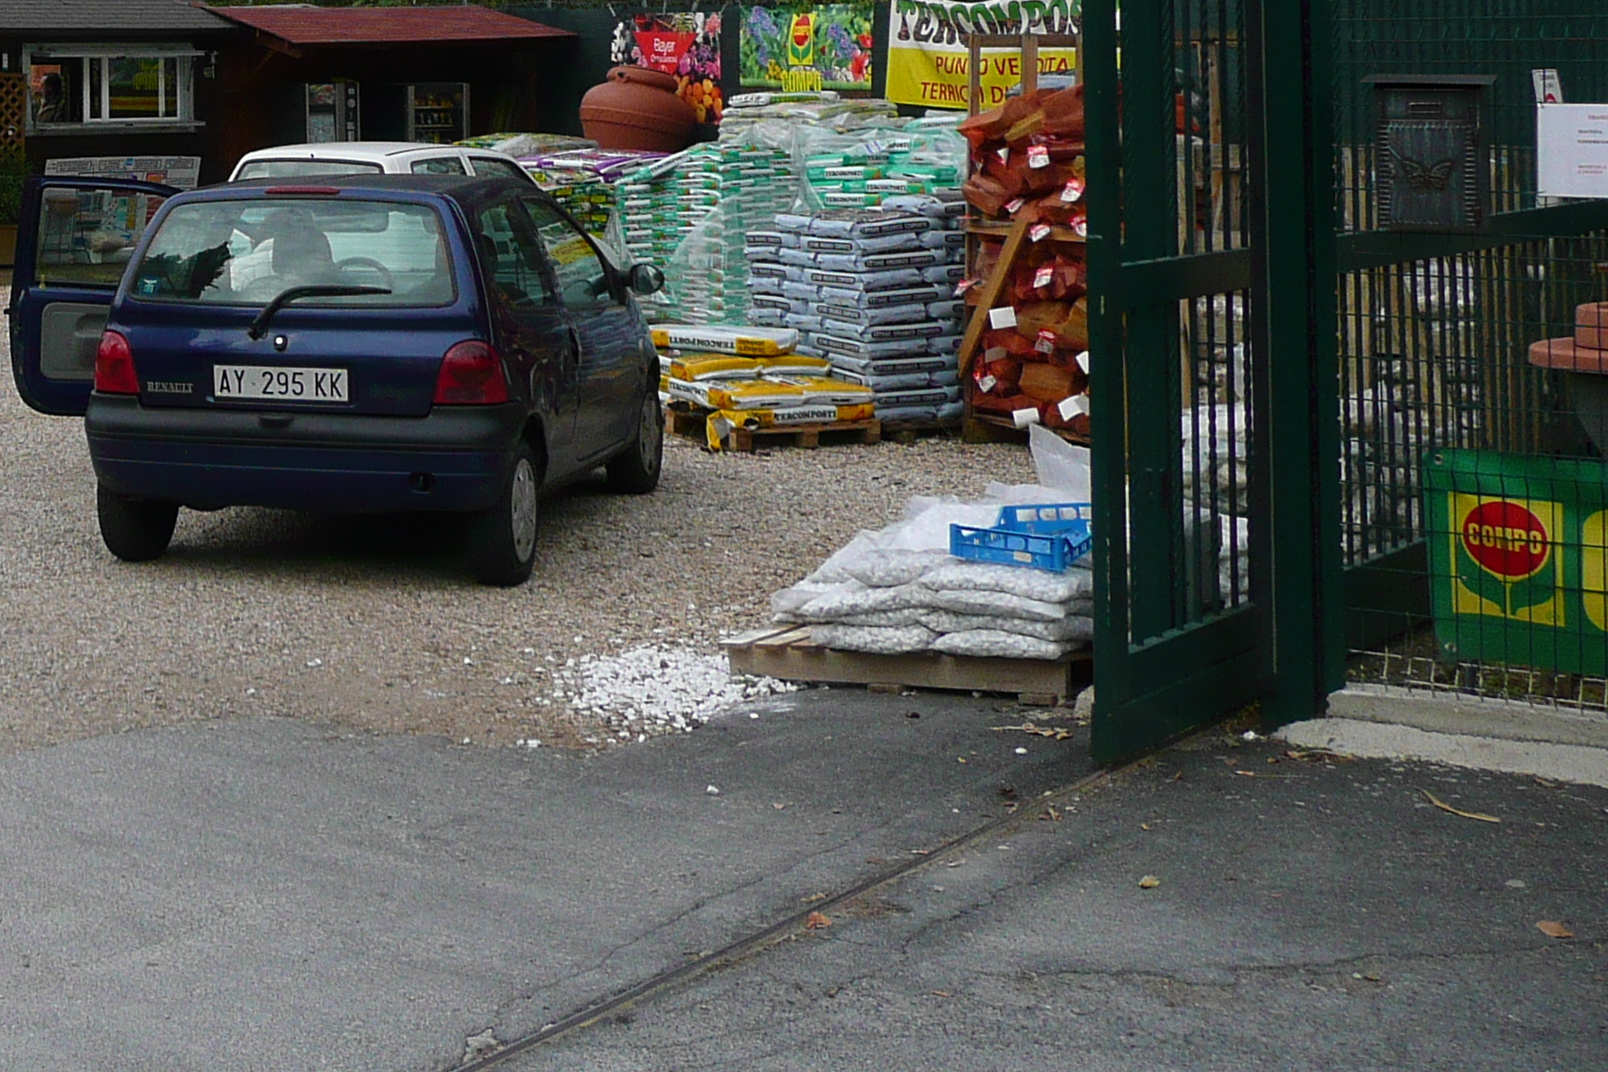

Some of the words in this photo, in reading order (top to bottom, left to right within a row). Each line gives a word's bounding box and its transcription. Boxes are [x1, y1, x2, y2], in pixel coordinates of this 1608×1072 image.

[653, 37, 676, 56] Bayer
[935, 56, 989, 76] PUNO
[994, 57, 1070, 76] VEDITA
[782, 70, 822, 92] COMPO
[921, 82, 985, 103] TERRICI
[147, 381, 194, 394] RENAULT
[219, 369, 245, 394] AY
[261, 371, 304, 396] 295
[314, 372, 342, 398] KK
[1467, 522, 1542, 555] COMPO
